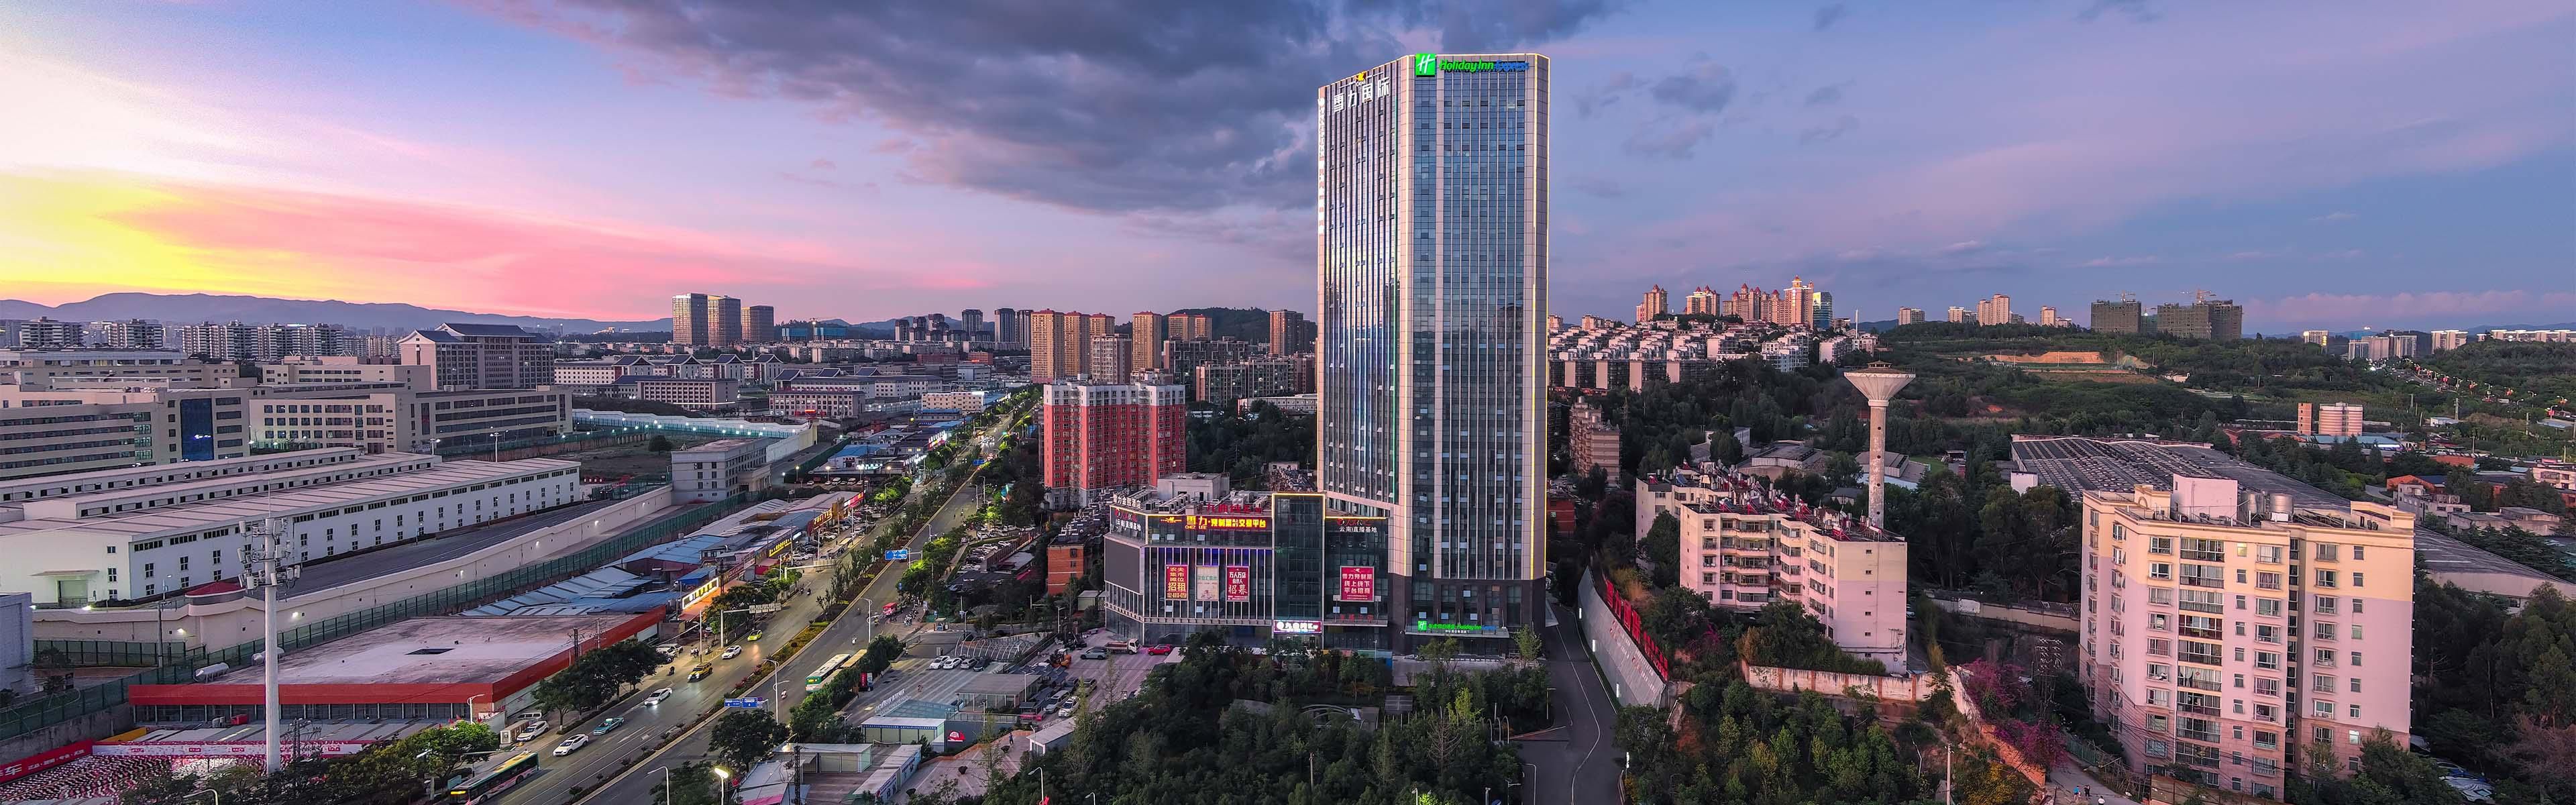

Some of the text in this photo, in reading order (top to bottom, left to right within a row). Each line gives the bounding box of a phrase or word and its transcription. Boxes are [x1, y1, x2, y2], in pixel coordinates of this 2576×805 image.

[1439, 59, 1478, 72] Holiday
[1479, 59, 1494, 70] Inn
[1168, 582, 1186, 591] 招租
[1228, 584, 1247, 595] 招募
